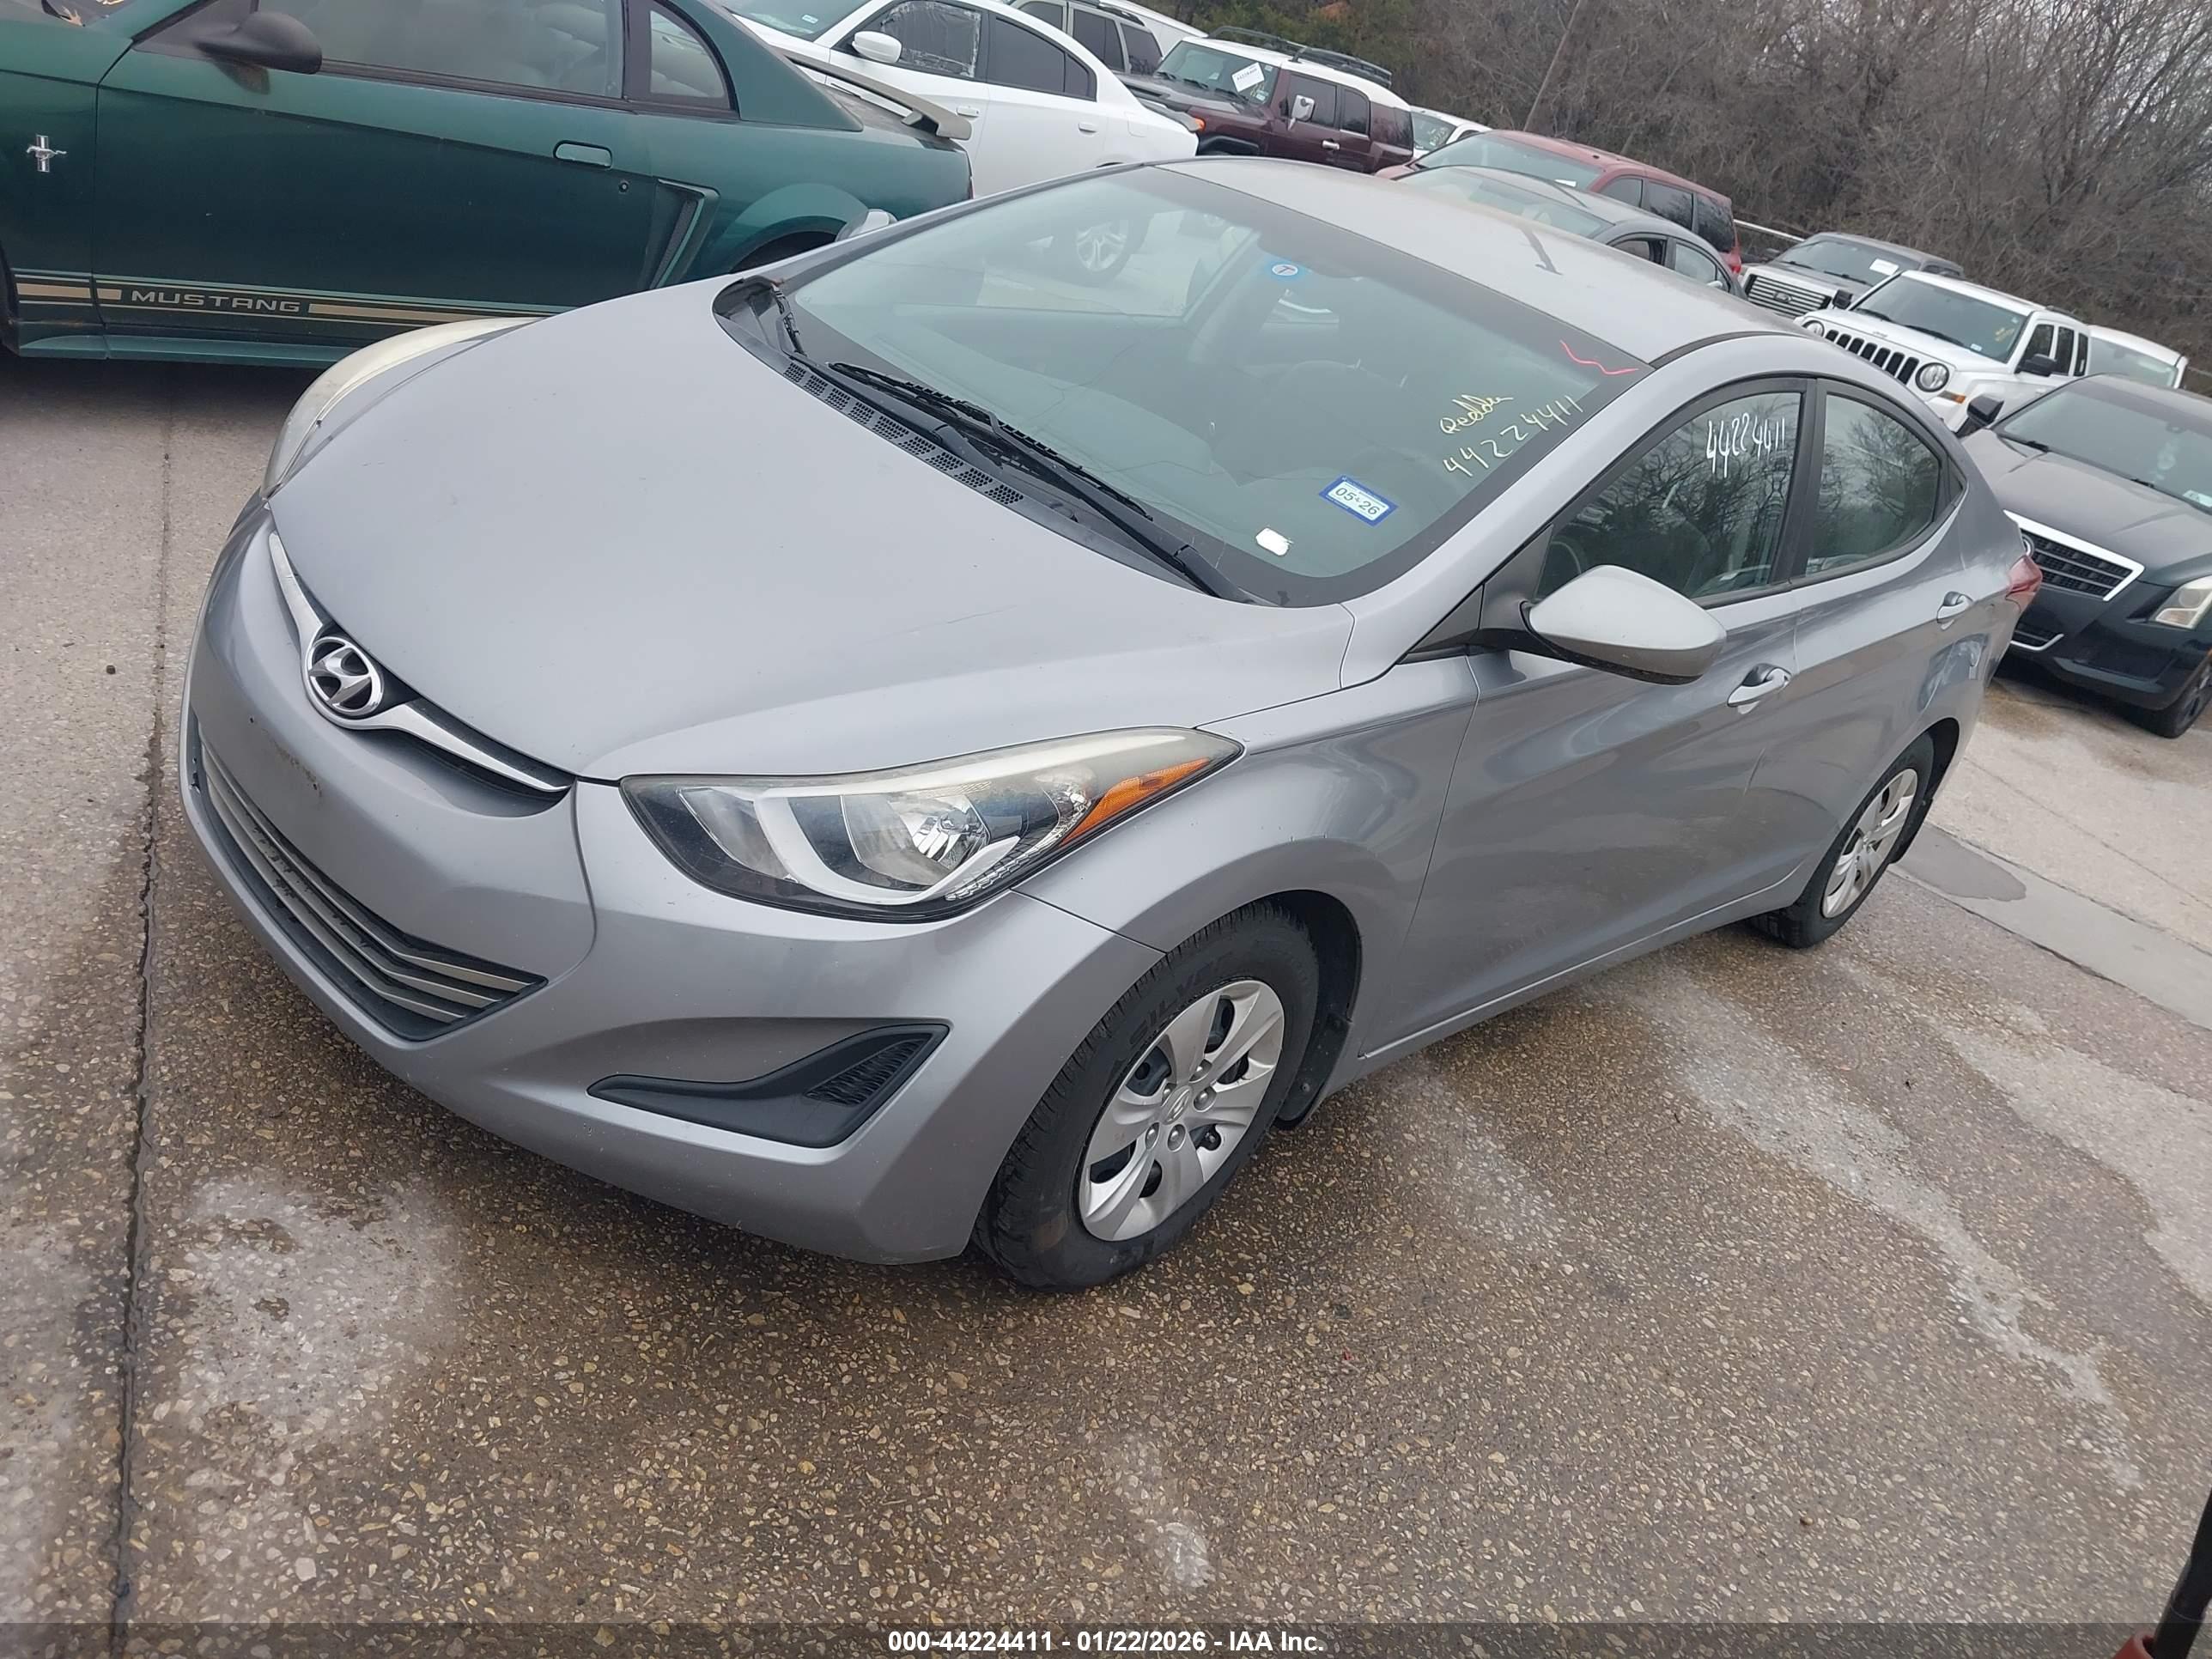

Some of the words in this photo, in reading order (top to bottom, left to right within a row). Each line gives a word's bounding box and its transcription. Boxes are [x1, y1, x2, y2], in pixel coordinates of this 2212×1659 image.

[131, 290, 301, 313] MUSTANG
[1442, 394, 1583, 477] 44224411
[1706, 412, 1785, 479] 44224411
